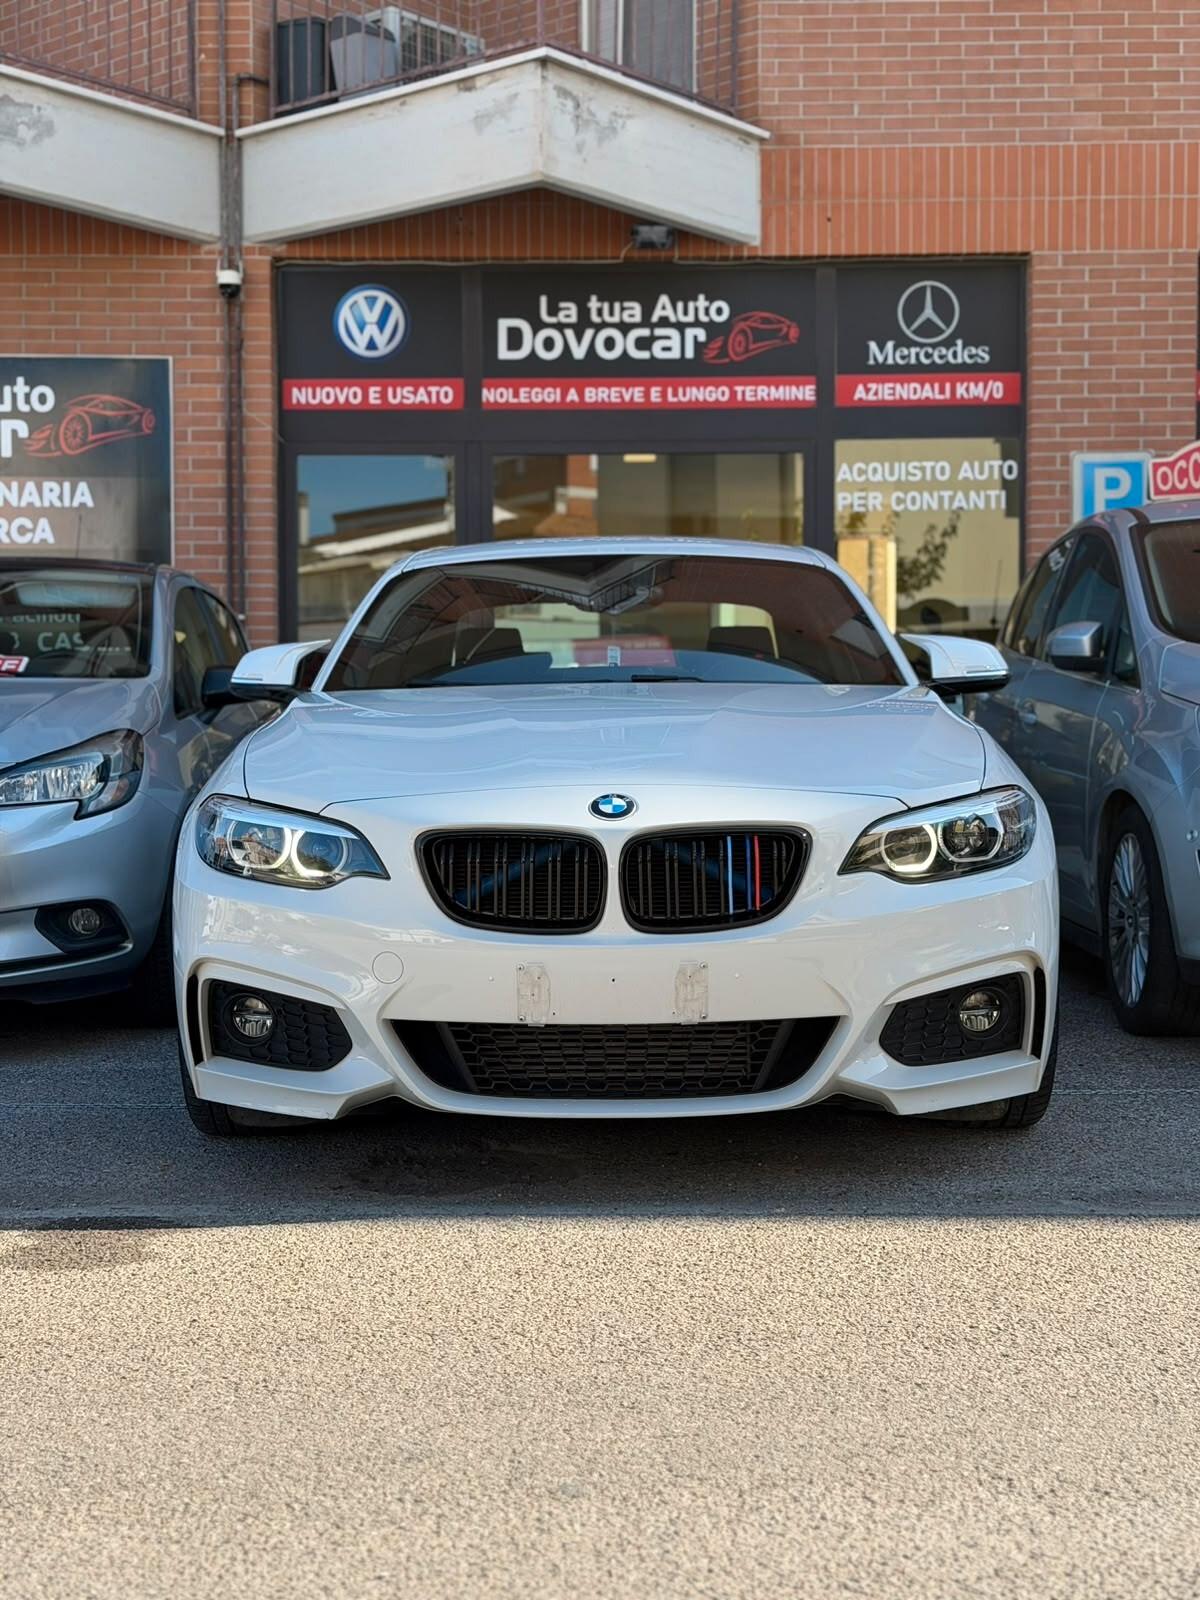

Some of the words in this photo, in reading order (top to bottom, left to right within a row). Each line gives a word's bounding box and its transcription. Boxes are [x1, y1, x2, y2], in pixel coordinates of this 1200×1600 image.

[539, 294, 578, 323] La
[587, 294, 642, 323] tua
[650, 293, 731, 323] Auto
[497, 317, 707, 361] Dovocar
[866, 339, 990, 366] Mercedes
[291, 386, 363, 405] NUOVO
[368, 386, 382, 405] E
[387, 385, 454, 405] USATO
[481, 387, 561, 404] NOLEGGI
[566, 387, 580, 403] A
[584, 386, 645, 403] BREVE
[650, 386, 662, 403] E
[667, 385, 730, 402] LUNGO
[733, 384, 816, 402] TERMINE
[853, 382, 951, 401] AZIENDALI
[836, 461, 951, 482] ACQUISTO
[957, 460, 1018, 481] AUTO
[0, 481, 94, 508] NARIA
[837, 491, 883, 512] PER
[891, 490, 1006, 511] CONTANTI
[1094, 467, 1131, 514] P
